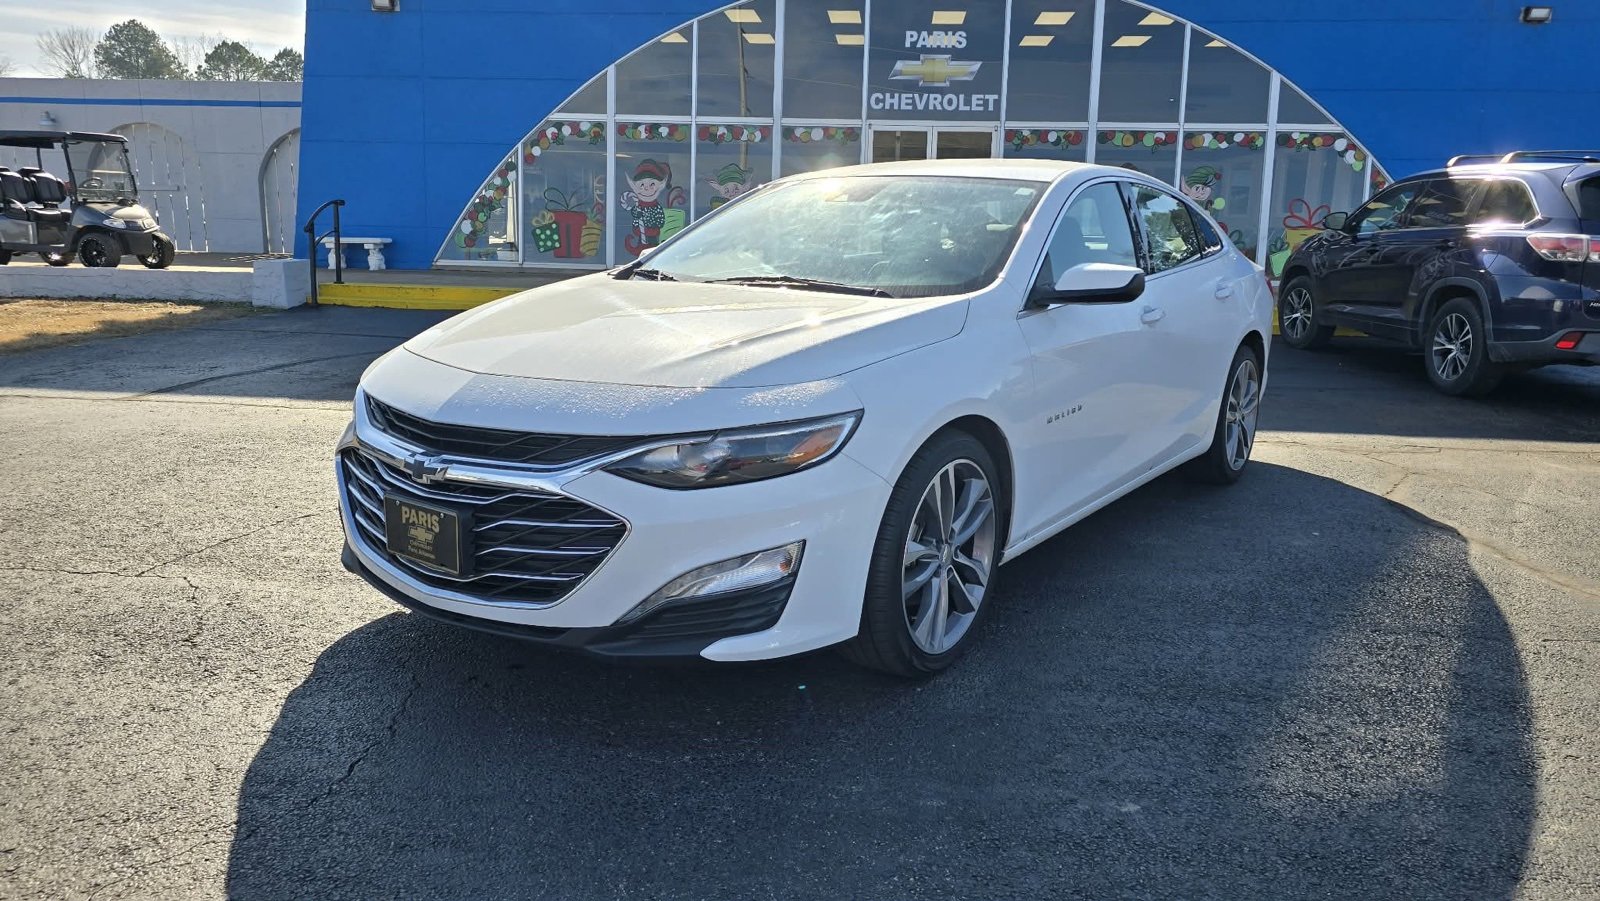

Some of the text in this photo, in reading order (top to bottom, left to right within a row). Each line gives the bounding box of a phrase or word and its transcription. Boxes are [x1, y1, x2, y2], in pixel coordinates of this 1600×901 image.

[905, 31, 967, 48] PARIS
[870, 93, 998, 111] CHEVROLET
[401, 506, 440, 533] PARIS
